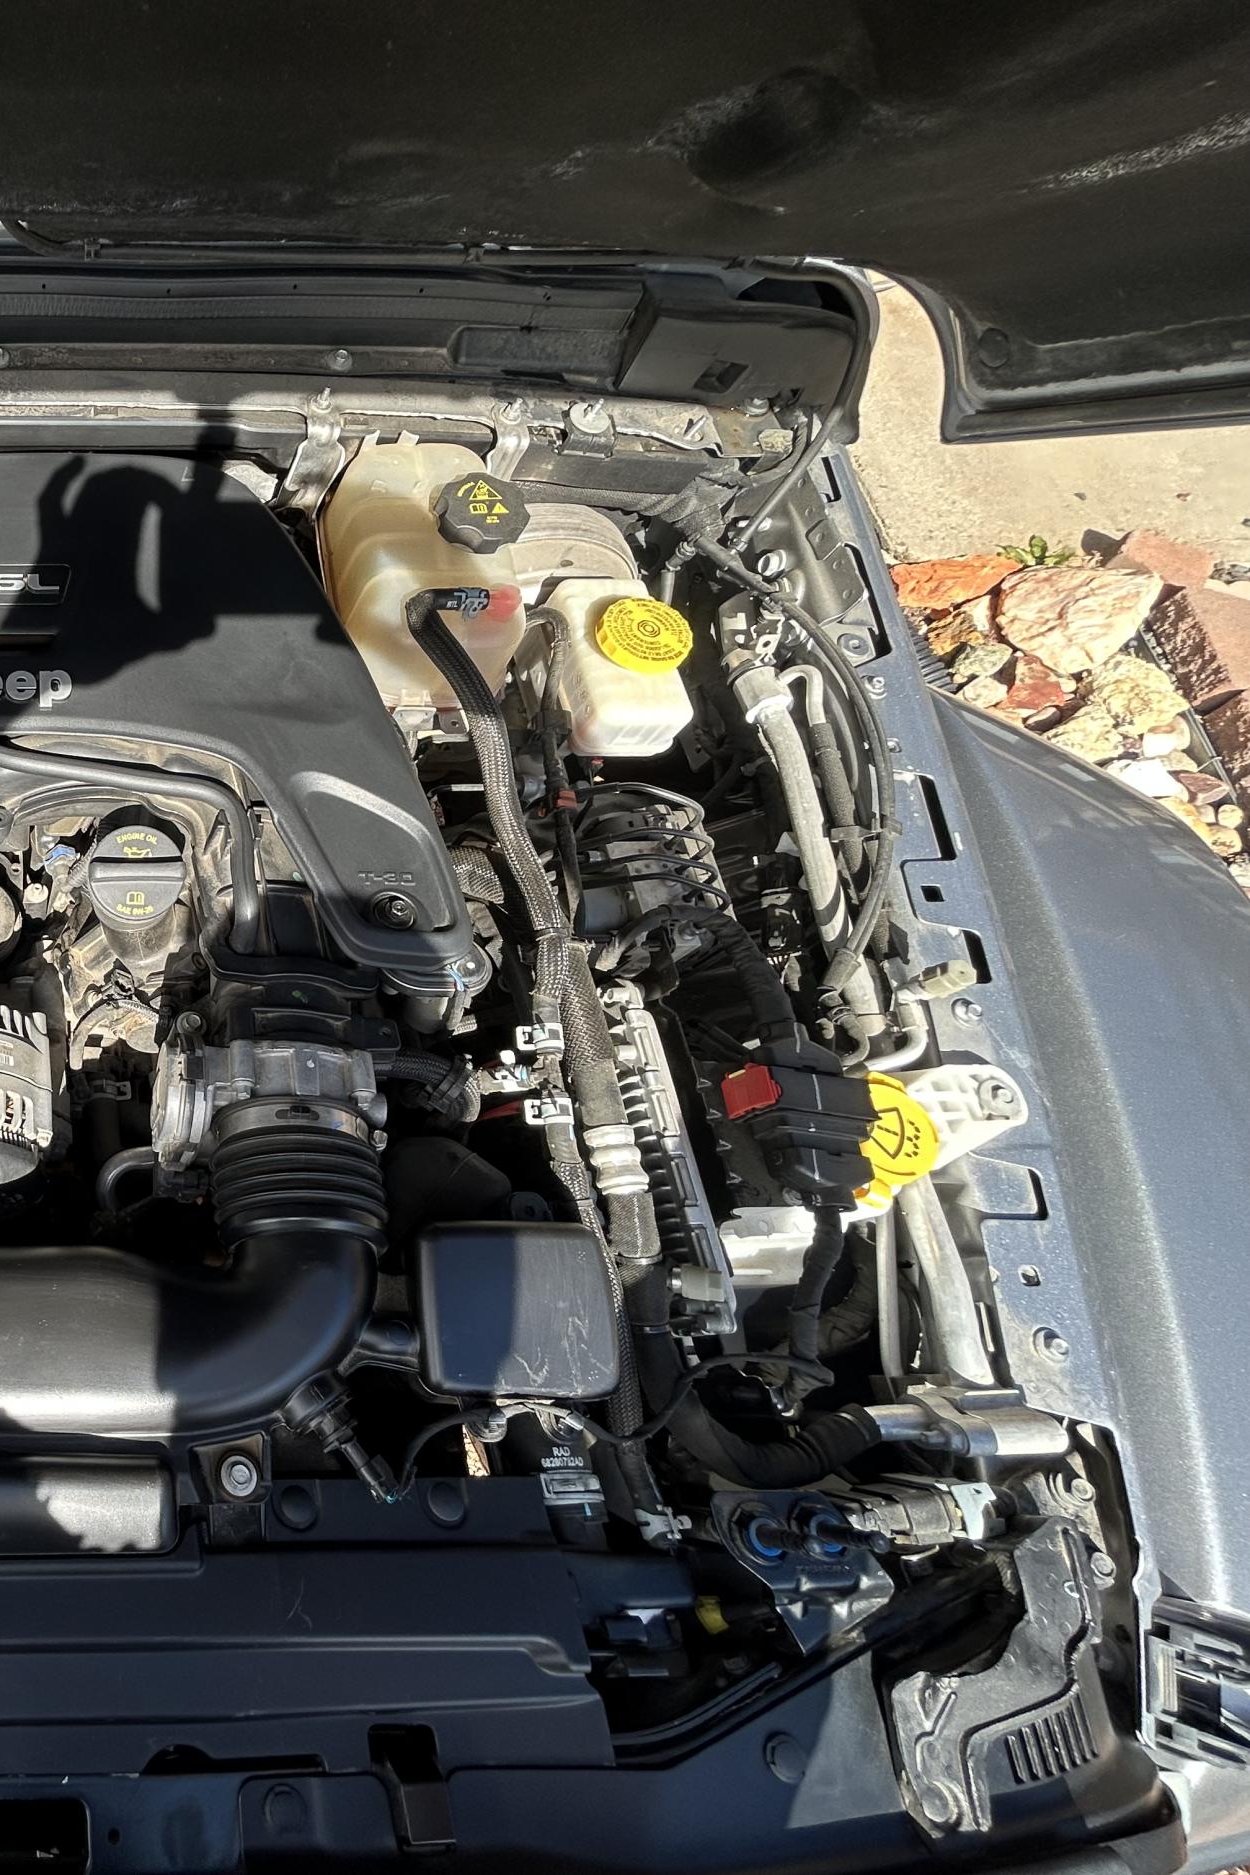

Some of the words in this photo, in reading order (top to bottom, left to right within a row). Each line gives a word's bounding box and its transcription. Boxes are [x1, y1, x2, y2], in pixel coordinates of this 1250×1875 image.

[116, 832, 146, 844] ENGINE
[146, 834, 158, 845] OIL
[358, 871, 417, 886] T-30
[552, 1446, 571, 1457] RAD
